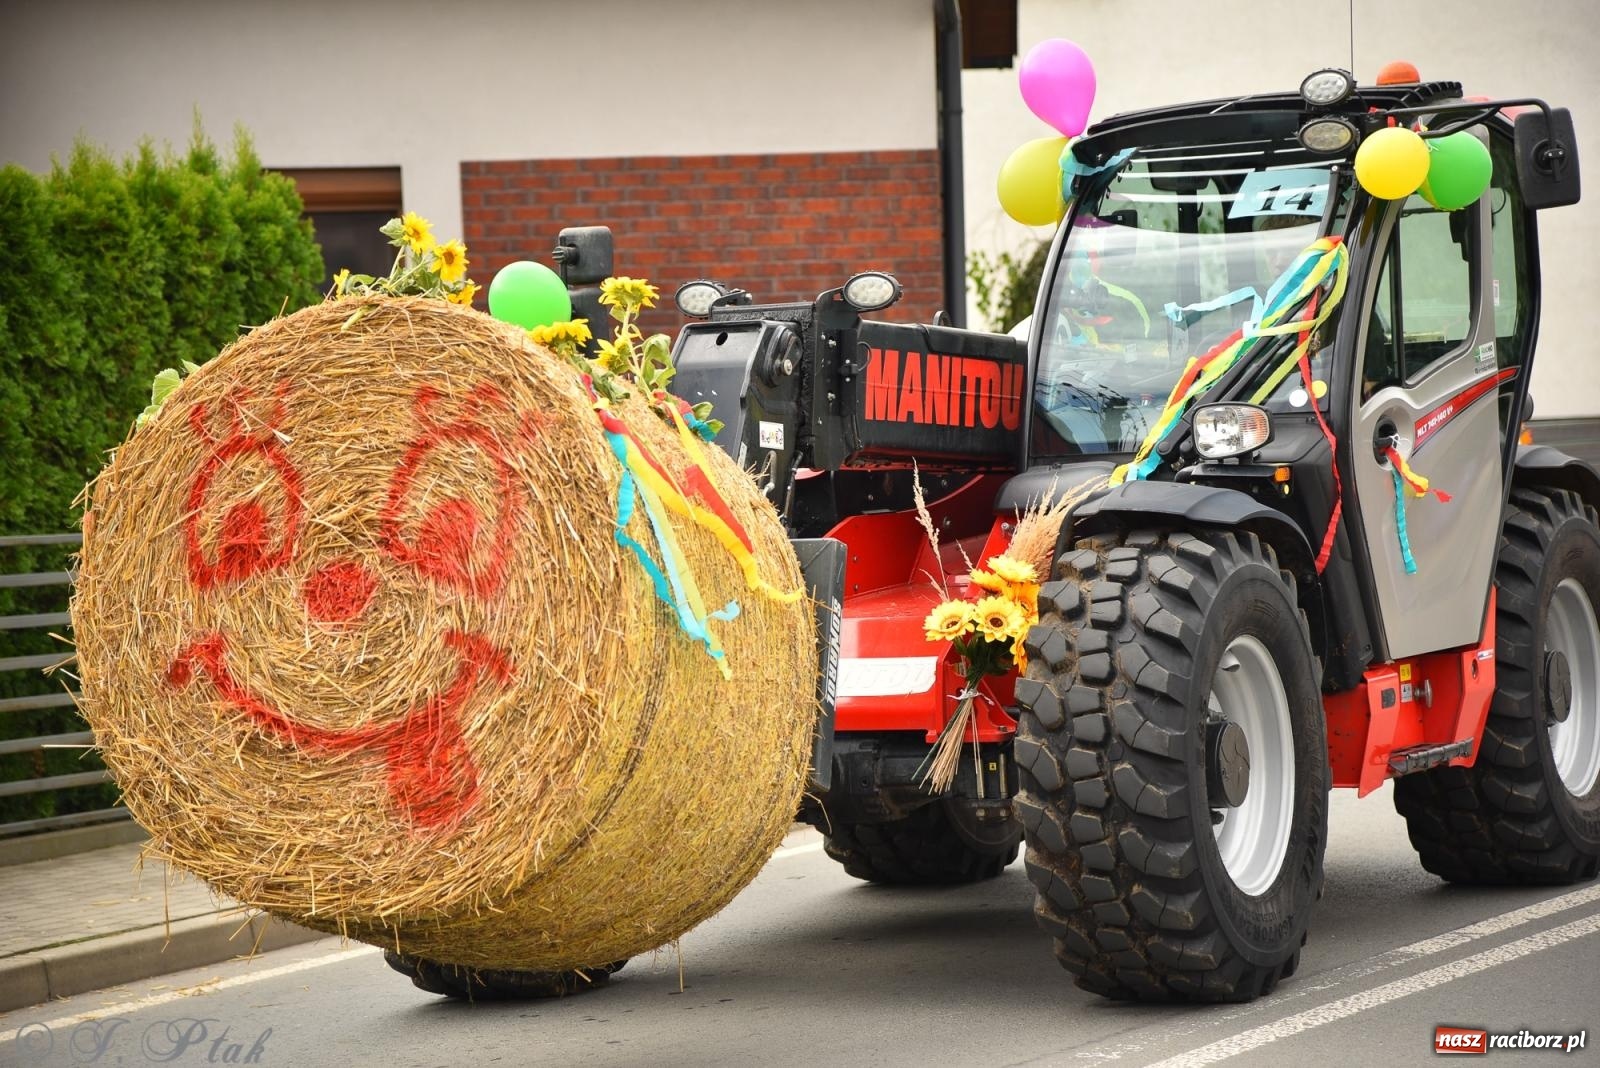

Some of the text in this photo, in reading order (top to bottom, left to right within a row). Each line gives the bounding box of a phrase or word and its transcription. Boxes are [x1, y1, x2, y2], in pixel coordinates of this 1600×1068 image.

[1255, 184, 1317, 211] 14
[865, 348, 1024, 431] MANITOU
[826, 598, 842, 707] SONAROL
